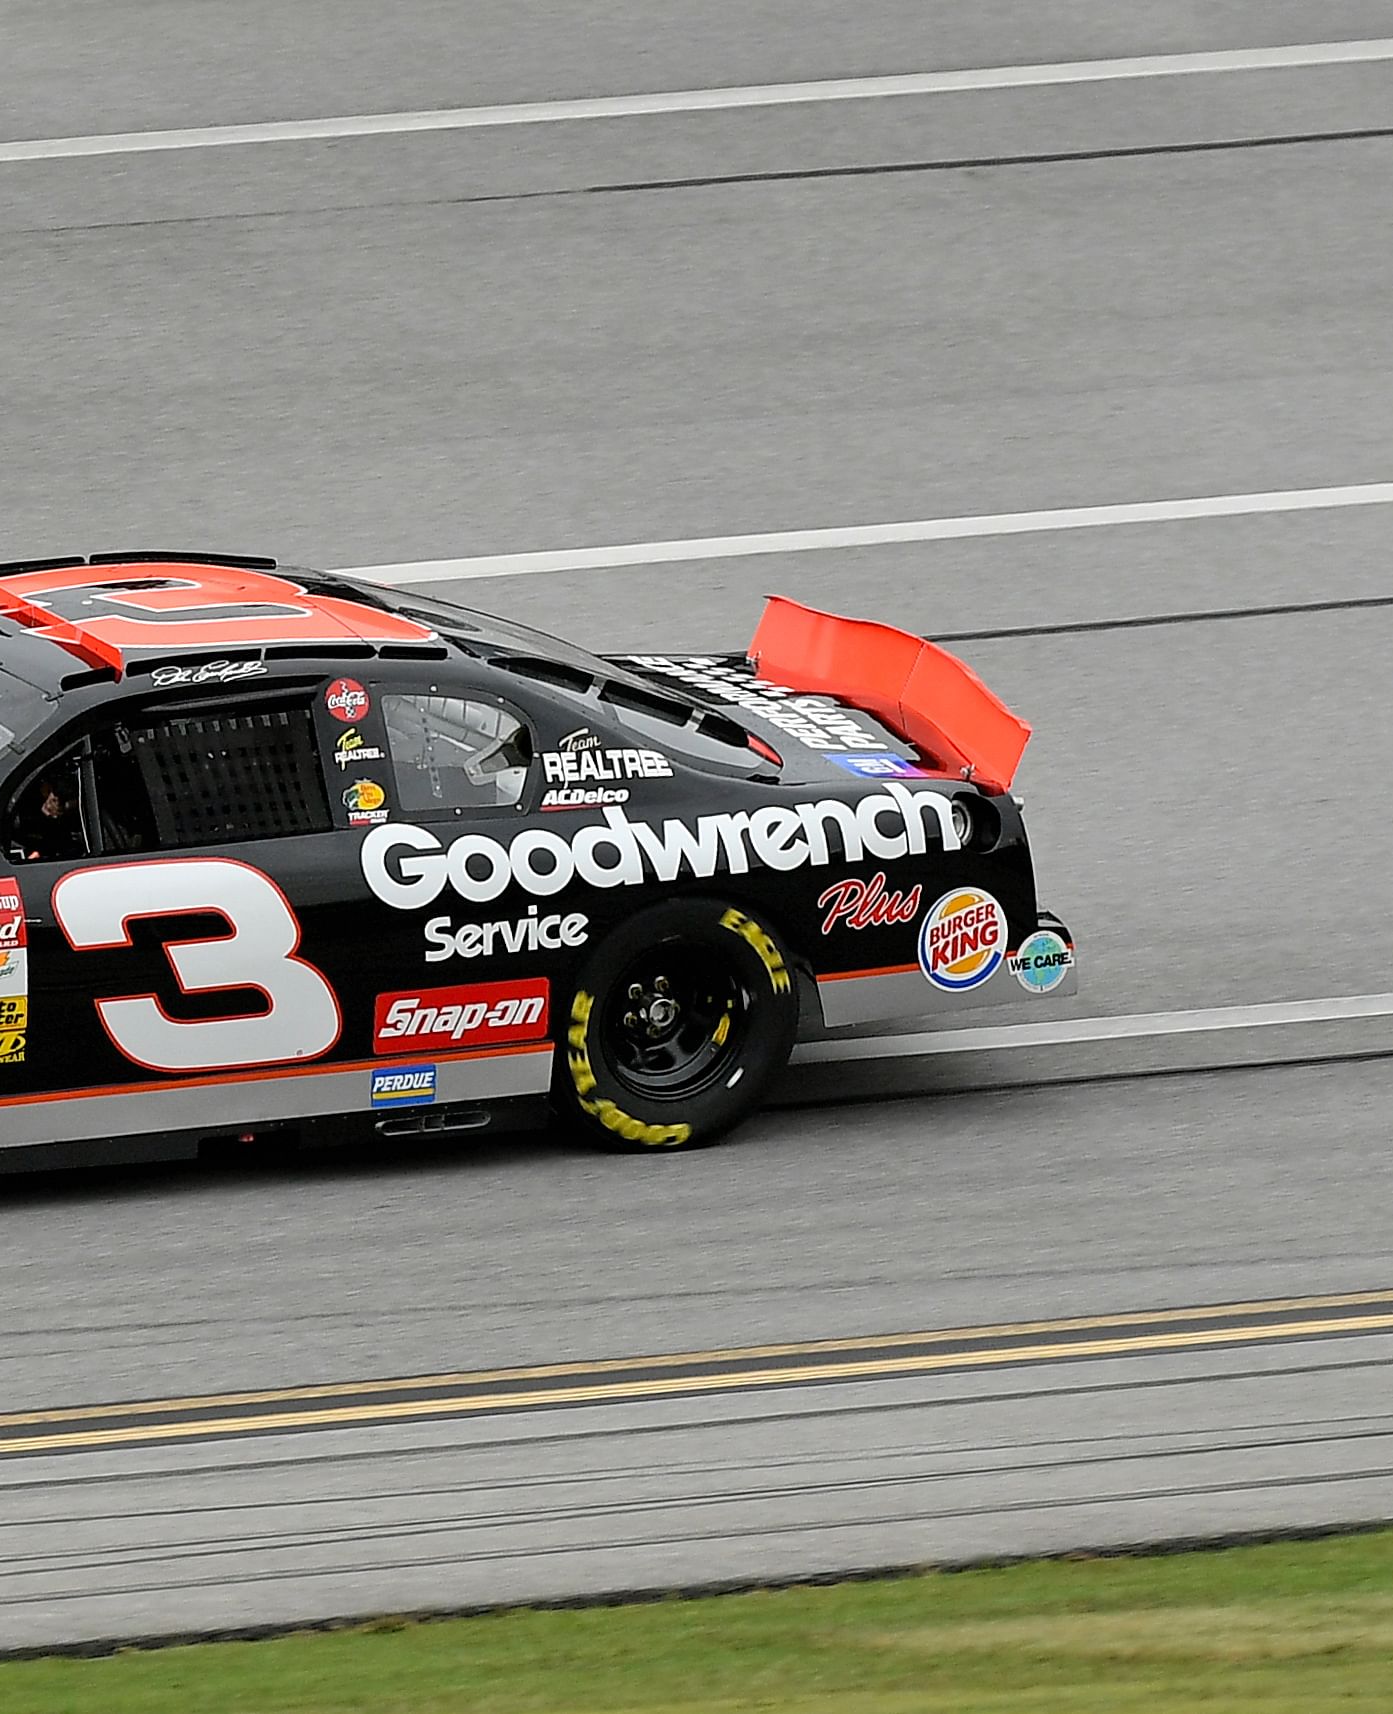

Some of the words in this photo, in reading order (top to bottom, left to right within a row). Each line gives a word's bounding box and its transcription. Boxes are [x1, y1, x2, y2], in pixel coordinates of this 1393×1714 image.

[559, 728, 601, 752] Team
[780, 697, 889, 750] PARTS
[542, 749, 673, 783] REALTREE
[361, 782, 962, 909] Goodwrench
[817, 871, 922, 935] Plus
[929, 902, 995, 947] BURGER
[424, 904, 589, 962] Service
[931, 920, 999, 971] KING
[50, 857, 342, 1073] 3
[1010, 957, 1031, 971] WE
[378, 997, 545, 1040] Snap-on
[373, 1072, 434, 1093] PERDUE
